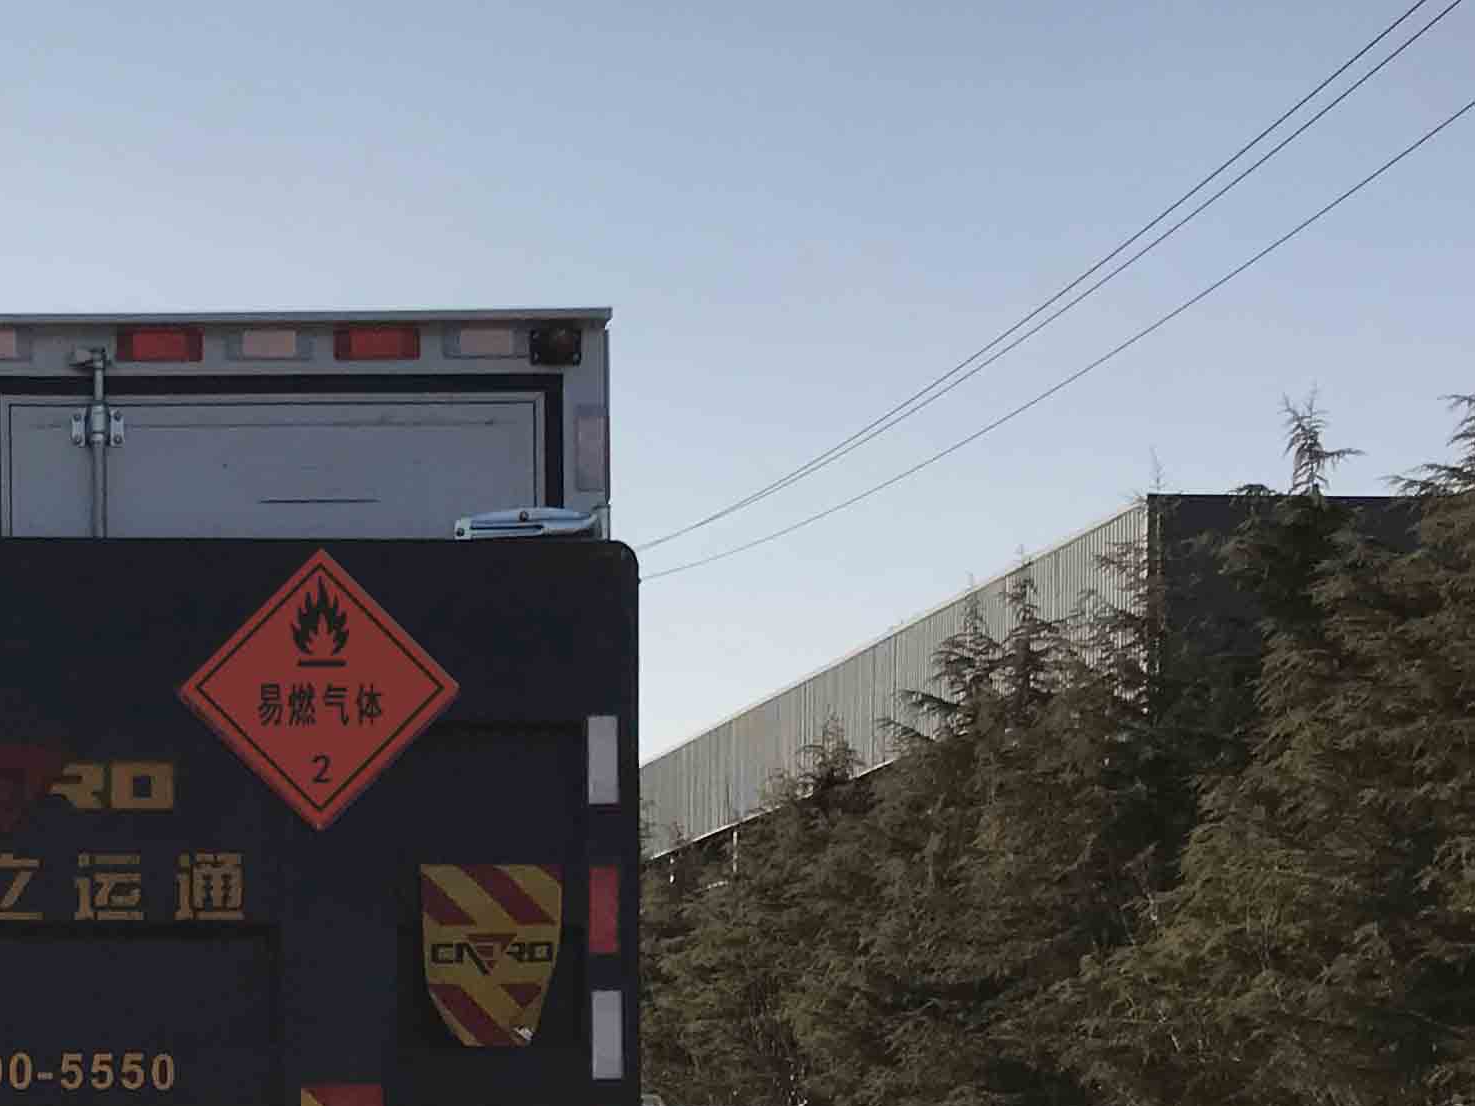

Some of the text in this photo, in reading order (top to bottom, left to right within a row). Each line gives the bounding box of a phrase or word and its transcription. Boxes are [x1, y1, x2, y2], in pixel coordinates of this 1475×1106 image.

[257, 682, 383, 727] 易燃气体
[311, 754, 331, 784] 2
